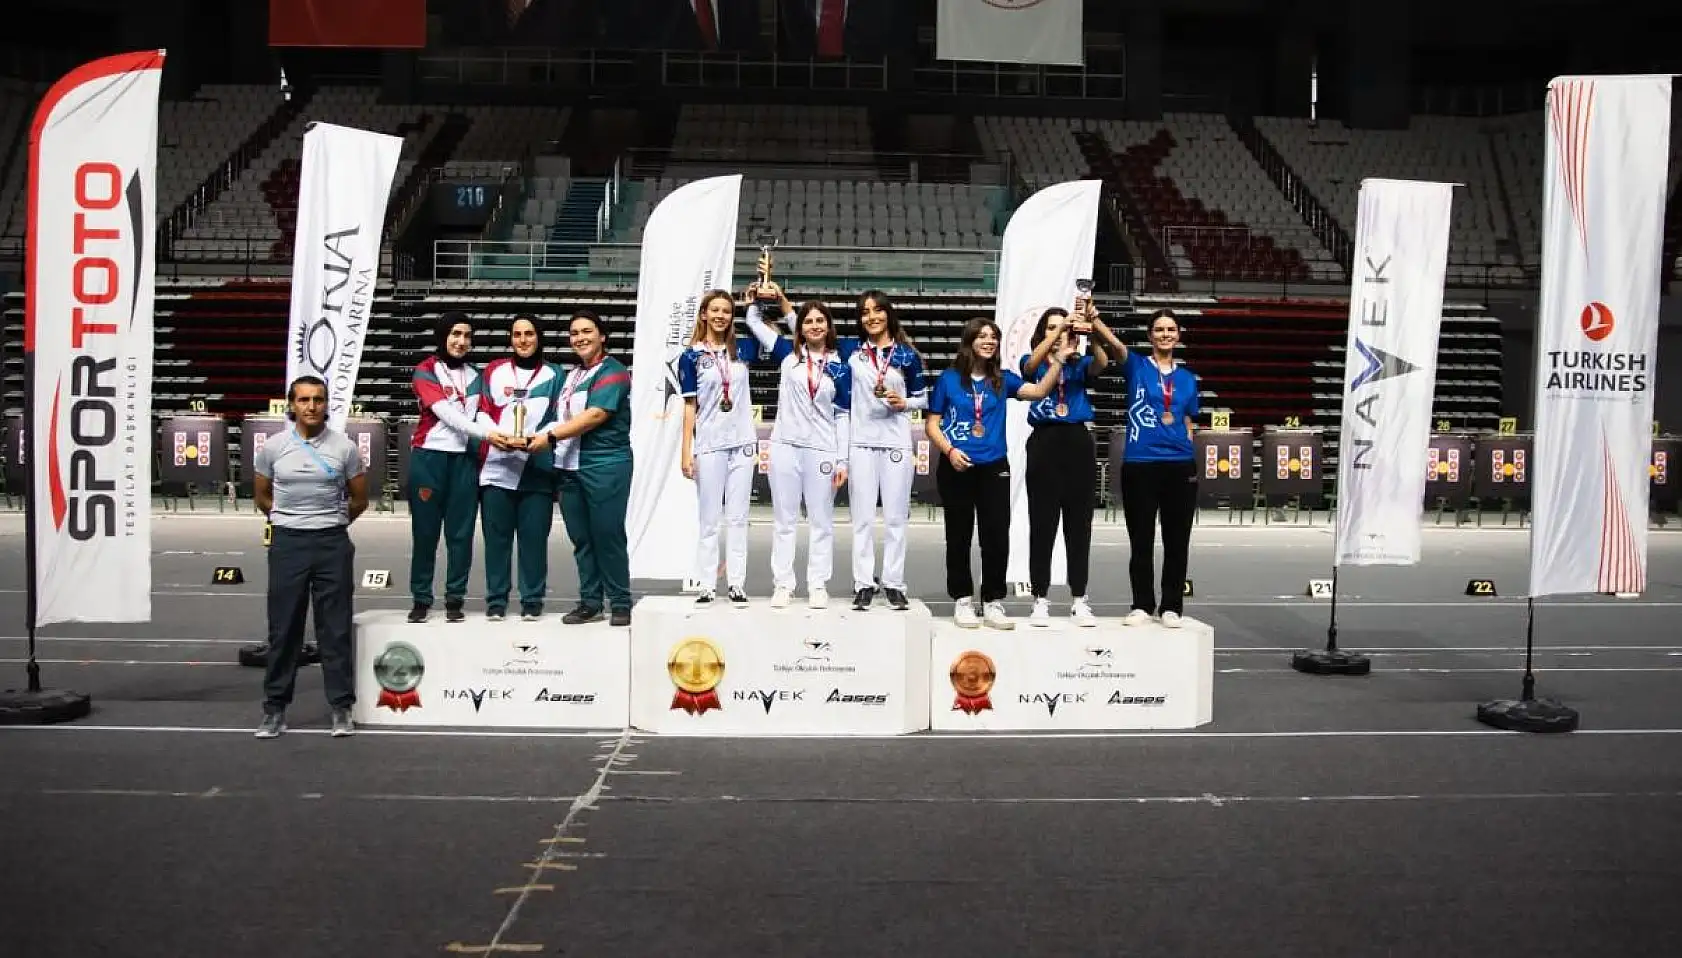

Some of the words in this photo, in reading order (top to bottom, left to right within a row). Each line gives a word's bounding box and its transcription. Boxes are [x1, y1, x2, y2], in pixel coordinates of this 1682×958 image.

[457, 186, 485, 206] 210
[308, 226, 360, 376] ORIA
[331, 338, 358, 415] SPORTS
[348, 268, 372, 335] ARENA
[1350, 254, 1424, 470] NAVEK
[1547, 351, 1646, 371] TURKISH
[1547, 372, 1646, 392] AIRLINES
[190, 400, 205, 412] 10
[1213, 415, 1228, 427] 23
[1285, 415, 1300, 428] 24
[1501, 421, 1514, 433] 27
[216, 569, 234, 581] 14
[367, 573, 384, 584] 15
[1314, 583, 1332, 594] 21
[1474, 581, 1494, 593] 22
[443, 688, 513, 714] NAVEK
[534, 687, 596, 702] Aases
[733, 689, 804, 715] NAVEK
[826, 687, 888, 703] Aases
[1019, 692, 1086, 717] NAVEK
